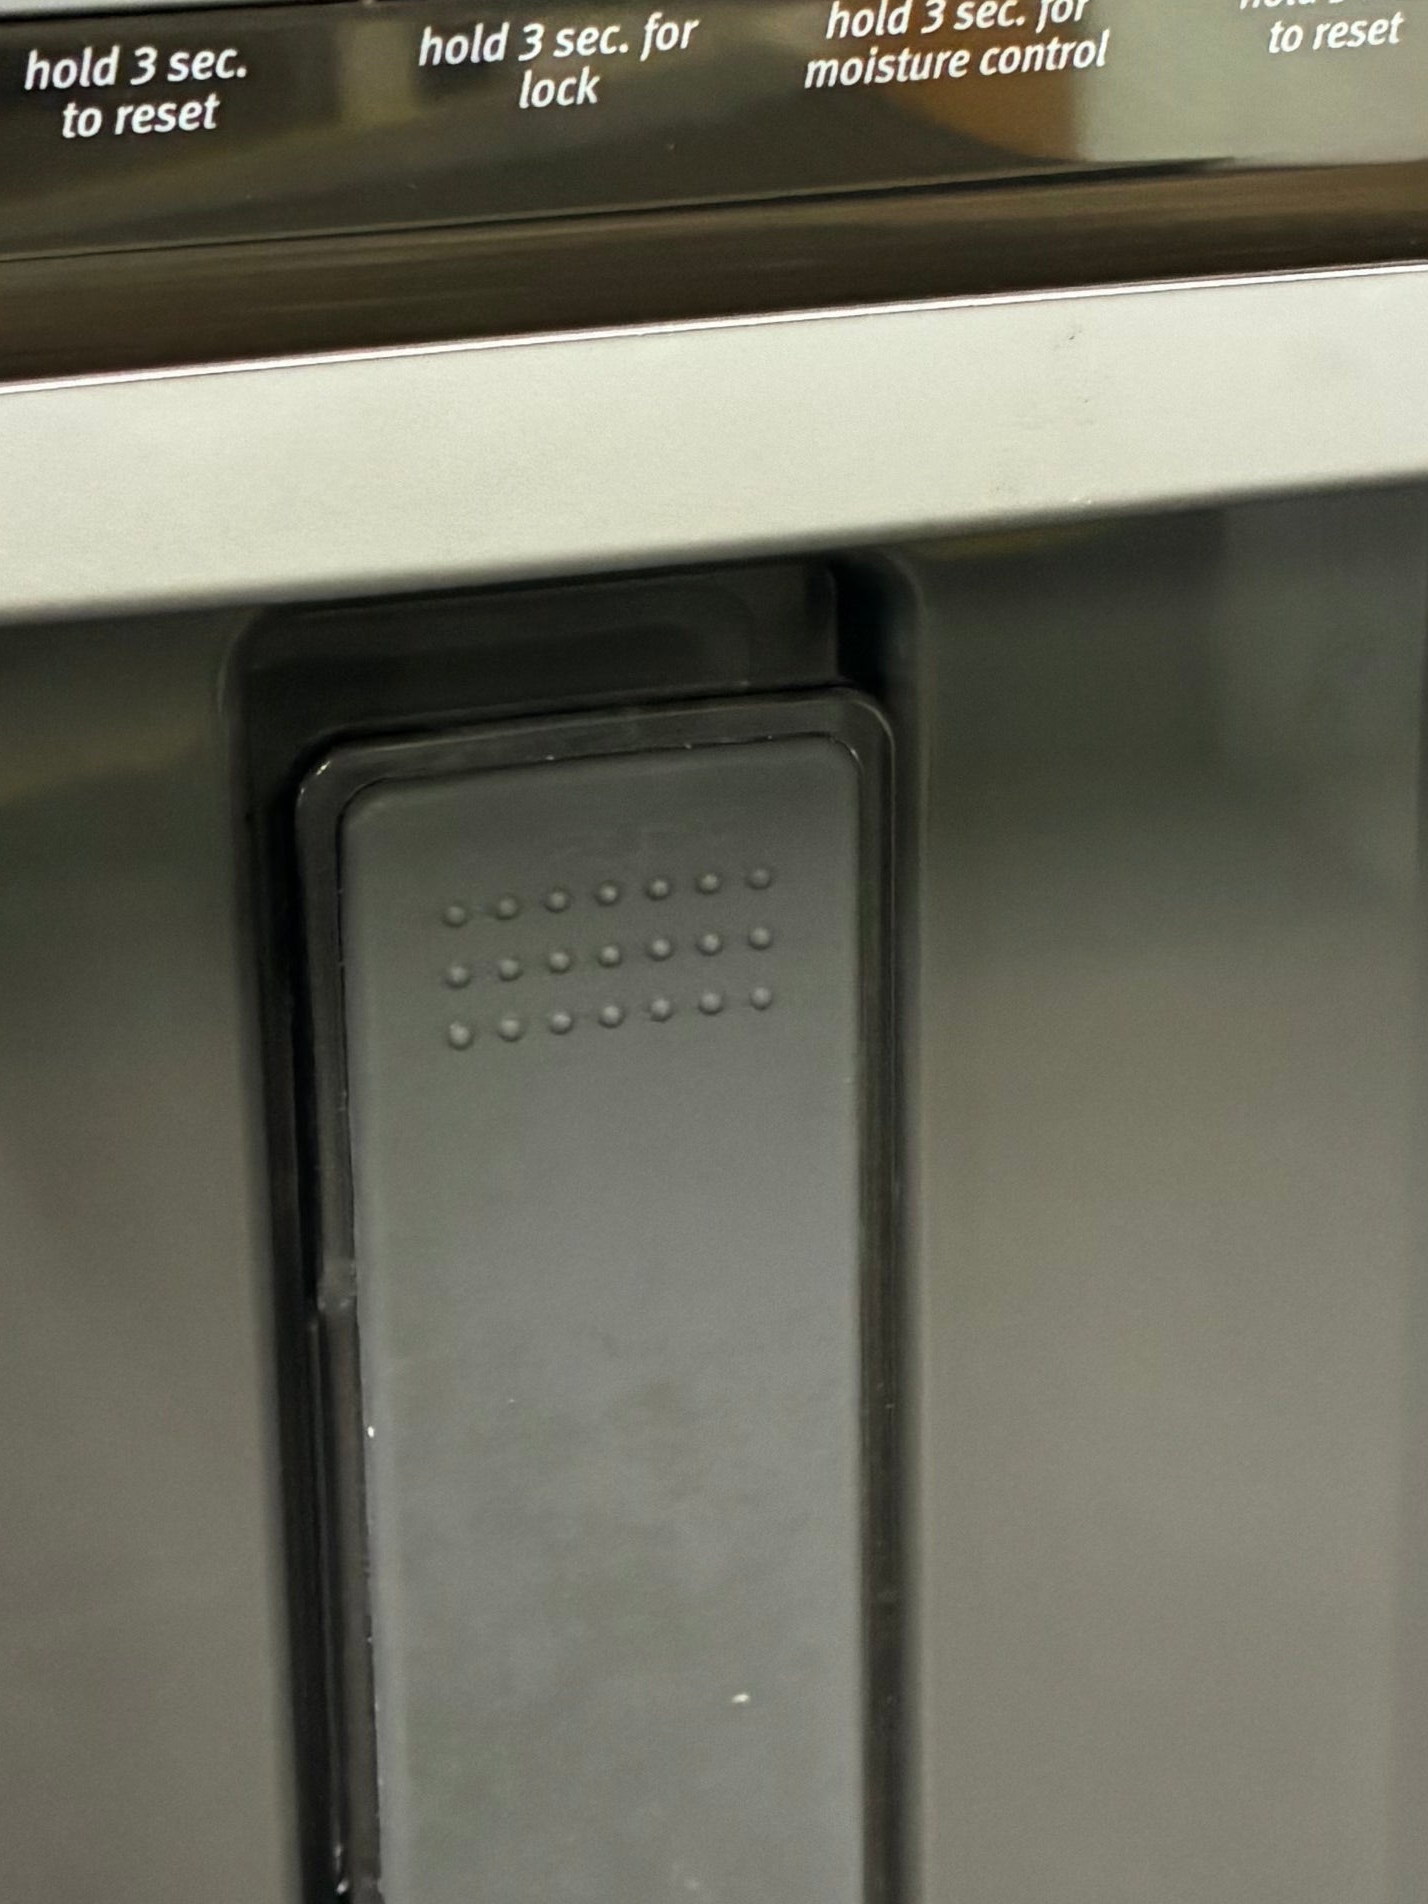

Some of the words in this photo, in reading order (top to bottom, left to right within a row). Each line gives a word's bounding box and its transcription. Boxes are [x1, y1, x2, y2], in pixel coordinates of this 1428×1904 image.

[419, 22, 510, 66] hold
[518, 23, 545, 61] 3
[553, 25, 628, 57] sec.
[640, 12, 700, 61] for
[1269, 21, 1303, 53] to
[1313, 12, 1404, 49] reset
[24, 45, 120, 90] hold
[130, 46, 157, 85] 3
[167, 48, 247, 81] sec.
[804, 45, 971, 89] moisture
[979, 29, 1110, 75] control
[519, 66, 600, 109] lock
[62, 102, 102, 138] to
[115, 93, 220, 135] reset
